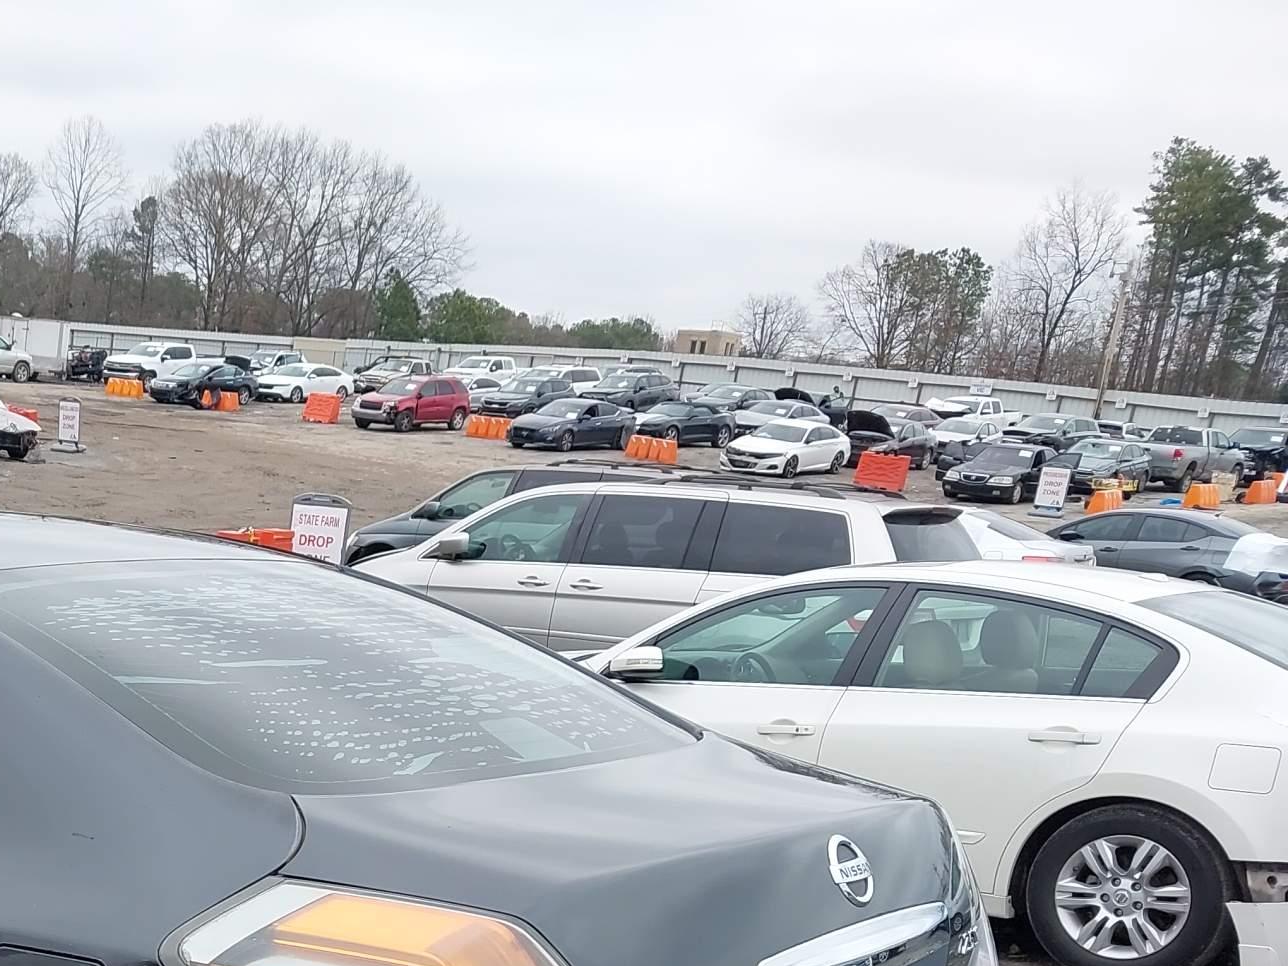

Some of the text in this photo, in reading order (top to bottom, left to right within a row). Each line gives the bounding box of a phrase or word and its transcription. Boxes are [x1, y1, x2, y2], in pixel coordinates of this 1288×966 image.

[1043, 480, 1063, 488] DROP
[298, 513, 341, 528] STATE FARM
[298, 534, 334, 548] DROP
